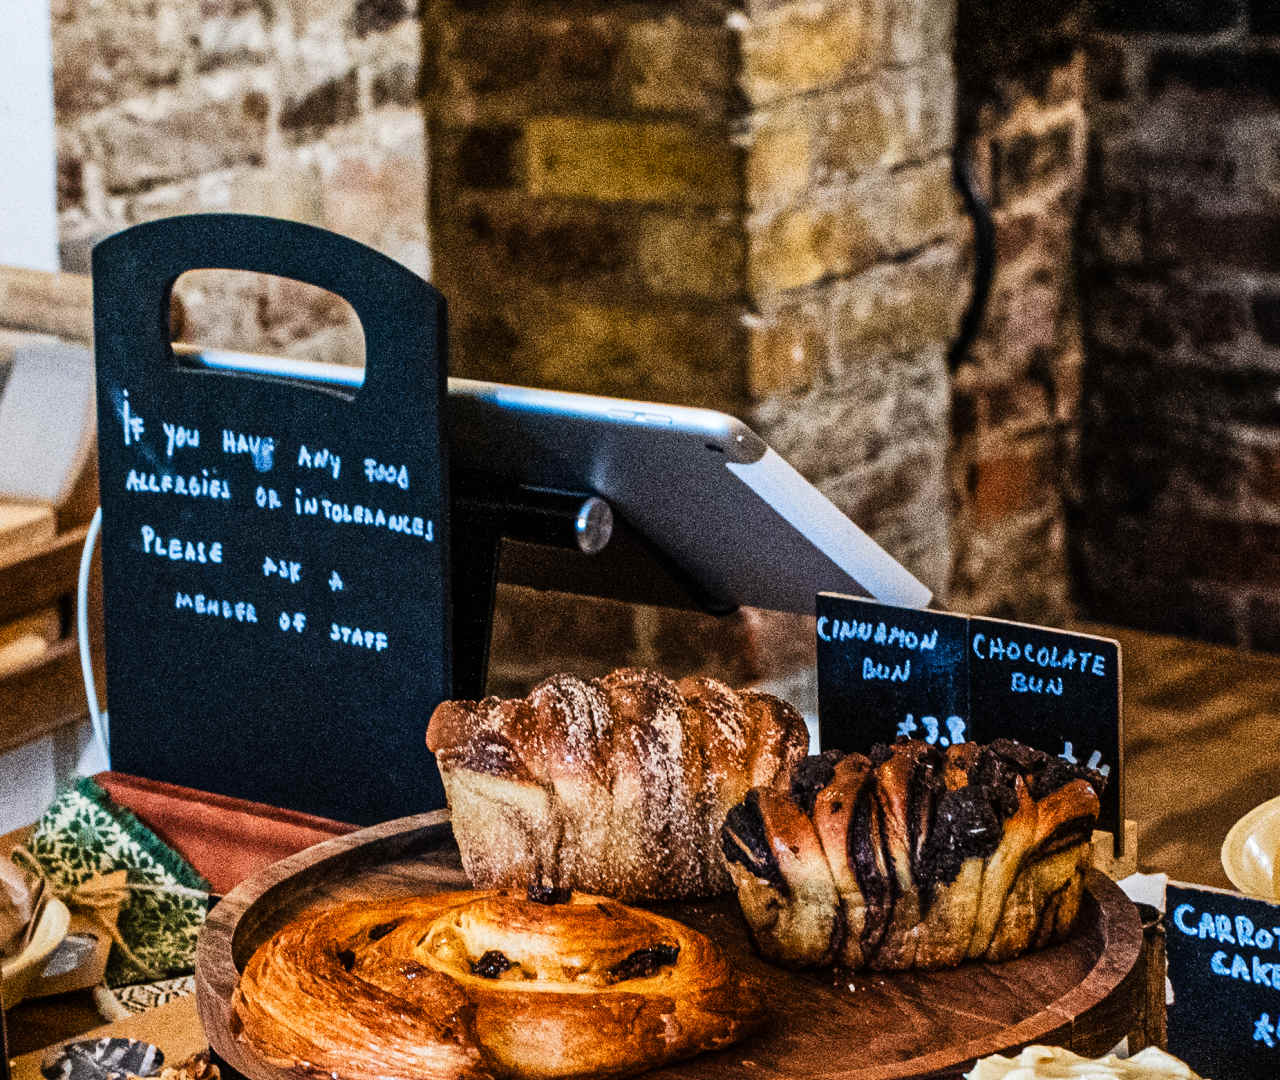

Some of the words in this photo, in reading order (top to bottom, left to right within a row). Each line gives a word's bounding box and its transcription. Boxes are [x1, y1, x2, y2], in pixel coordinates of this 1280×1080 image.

[255, 485, 282, 510] OR
[140, 524, 224, 564] PLEASE
[262, 556, 303, 584] ASK
[328, 570, 344, 593] A
[278, 611, 307, 634] OF
[329, 622, 389, 653] STAFF
[816, 615, 939, 651] CINNAMON
[862, 657, 911, 683] BUN
[971, 632, 1107, 677] CHOCOLATE
[1010, 671, 1064, 697] BUN
